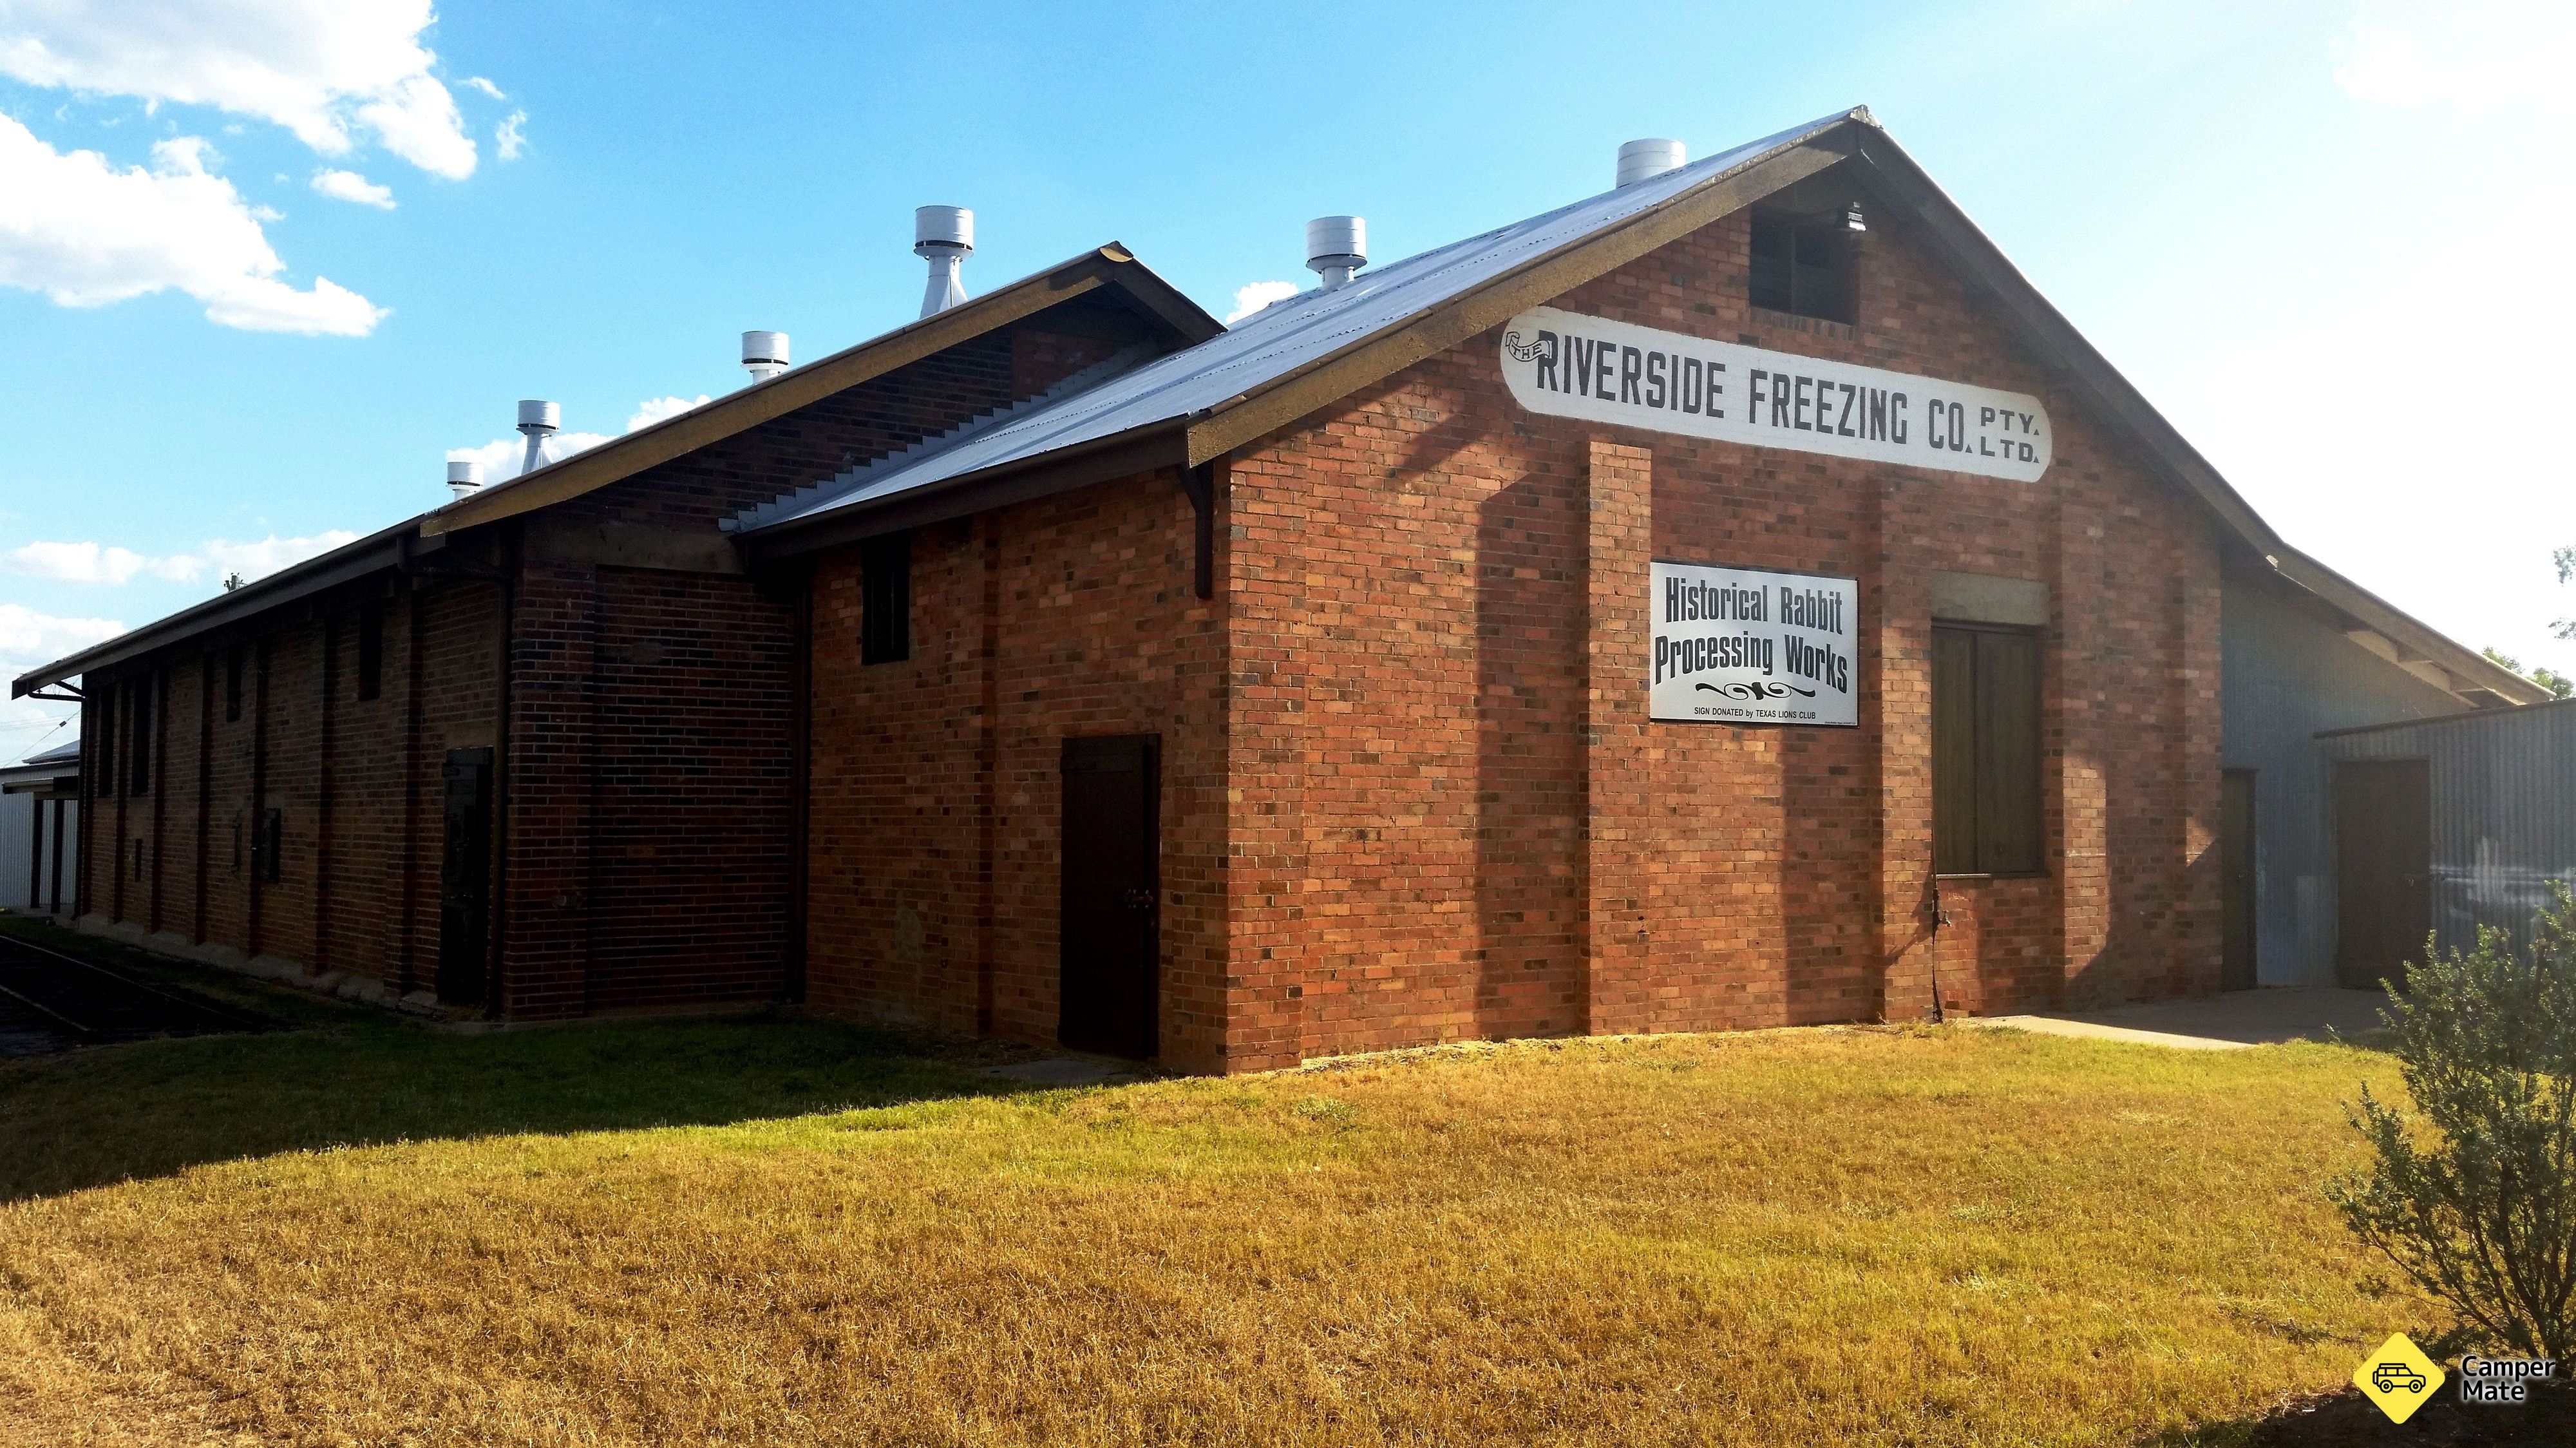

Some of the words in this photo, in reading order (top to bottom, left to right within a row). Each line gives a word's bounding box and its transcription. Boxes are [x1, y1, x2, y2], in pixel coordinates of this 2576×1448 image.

[1511, 343, 1542, 359] THE
[1537, 329, 1726, 418] RIVERSIDE
[1749, 368, 1908, 444] FREEZING
[1929, 399, 1973, 453] CO.
[1980, 406, 2040, 436] PTY.
[1980, 436, 2040, 464] LTD.
[1665, 576, 1768, 624] Historical
[1780, 586, 1842, 635] Rabbit
[1655, 631, 1773, 685] Processing
[1785, 634, 1847, 694] Works
[1694, 707, 1710, 715] SIGN
[1712, 707, 1743, 716] DONATED
[1746, 709, 1754, 718] by
[1778, 710, 1797, 719] LIONS
[1799, 711, 1816, 719] CLUB
